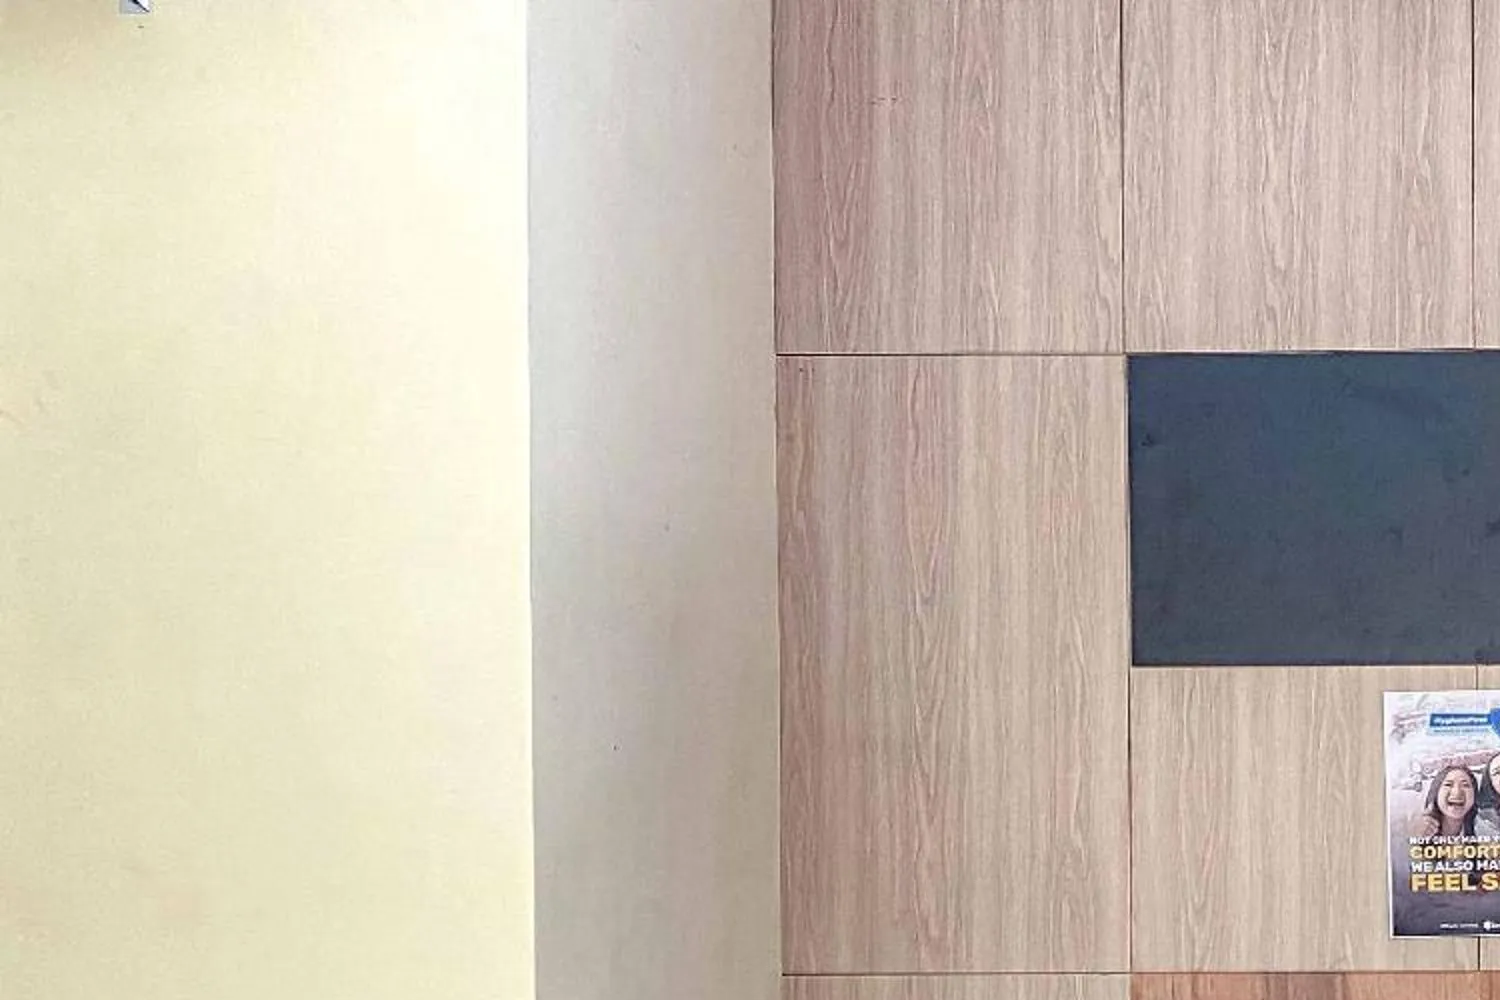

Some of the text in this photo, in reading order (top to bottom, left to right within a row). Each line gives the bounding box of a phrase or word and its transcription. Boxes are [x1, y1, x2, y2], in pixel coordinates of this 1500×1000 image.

[1409, 835, 1431, 845] NOT
[1411, 861, 1433, 873] WE
[1435, 860, 1473, 872] ALSO
[1411, 872, 1477, 892] FEEL
